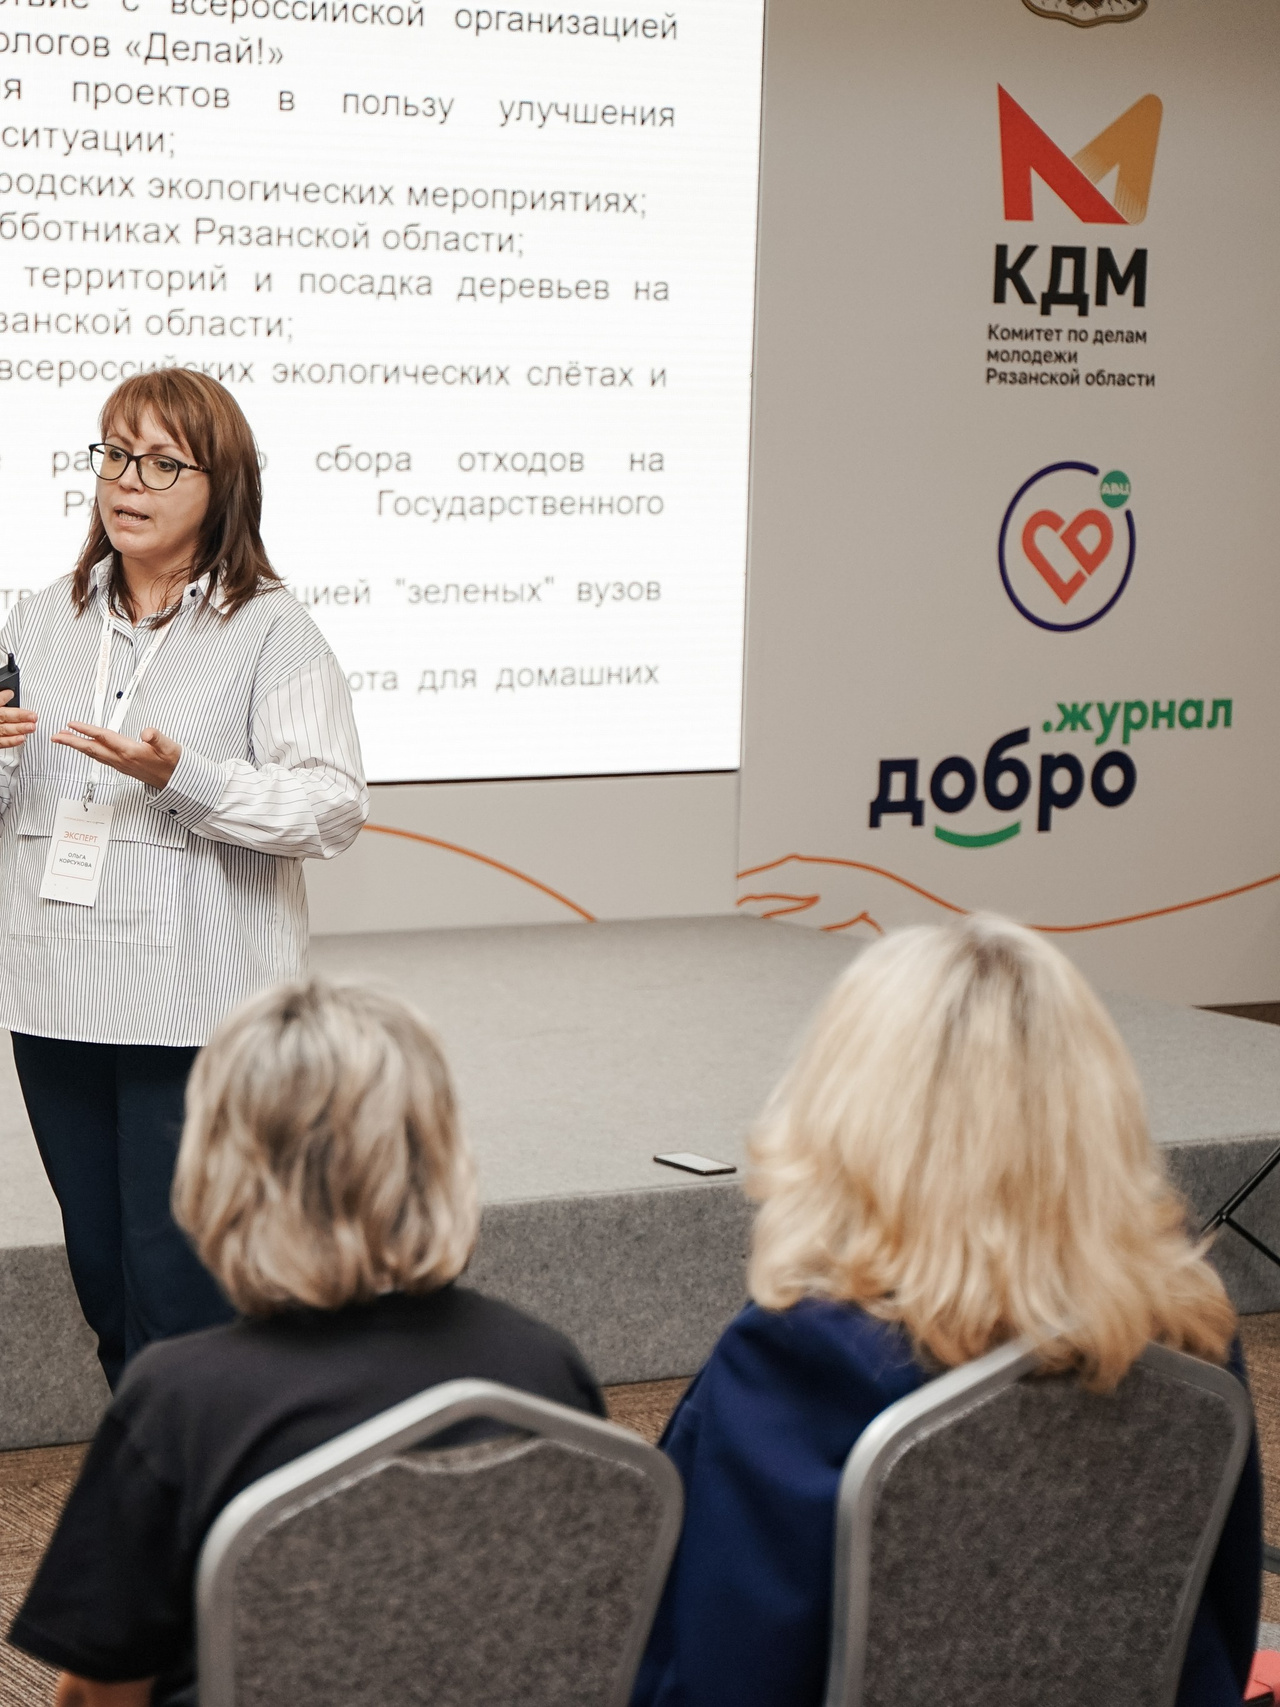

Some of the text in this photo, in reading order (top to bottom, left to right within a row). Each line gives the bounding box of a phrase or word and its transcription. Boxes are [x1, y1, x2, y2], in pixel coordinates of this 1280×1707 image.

[171, 0, 424, 27] всероссийской
[455, 9, 677, 42] организацией
[126, 32, 283, 66] «Делай!»
[73, 81, 230, 110] проектов
[279, 90, 295, 111] в
[343, 93, 454, 125] пользу
[499, 100, 675, 129] улучшения
[1, 126, 174, 158] ситуации;
[148, 177, 394, 205] экологических
[408, 186, 645, 219] мероприятиях;
[195, 217, 369, 249] Рязанской
[382, 222, 524, 258] области;
[24, 265, 226, 297] территорий
[255, 273, 272, 292] и
[300, 273, 432, 301] посадка
[456, 276, 610, 304] деревьев
[634, 281, 669, 301] на
[993, 244, 1148, 317] КДМ
[145, 308, 292, 342] области;
[988, 323, 1147, 346] Комитет по делам
[273, 362, 510, 386] экологических
[526, 361, 634, 387] слётах
[650, 369, 666, 387] и
[986, 349, 1078, 366] молодежи
[986, 367, 1155, 387] Рязанской области
[315, 444, 412, 478] сбора
[458, 451, 584, 477] отходов
[629, 452, 664, 472] на
[377, 489, 664, 523] Государственного
[395, 576, 554, 605] "зеленых"
[577, 581, 661, 608] вузов
[348, 669, 399, 692] ота
[417, 668, 477, 695] для
[495, 665, 659, 693] домашних
[868, 727, 1138, 832] добро
[64, 830, 98, 843] ЭКСПЕРТ
